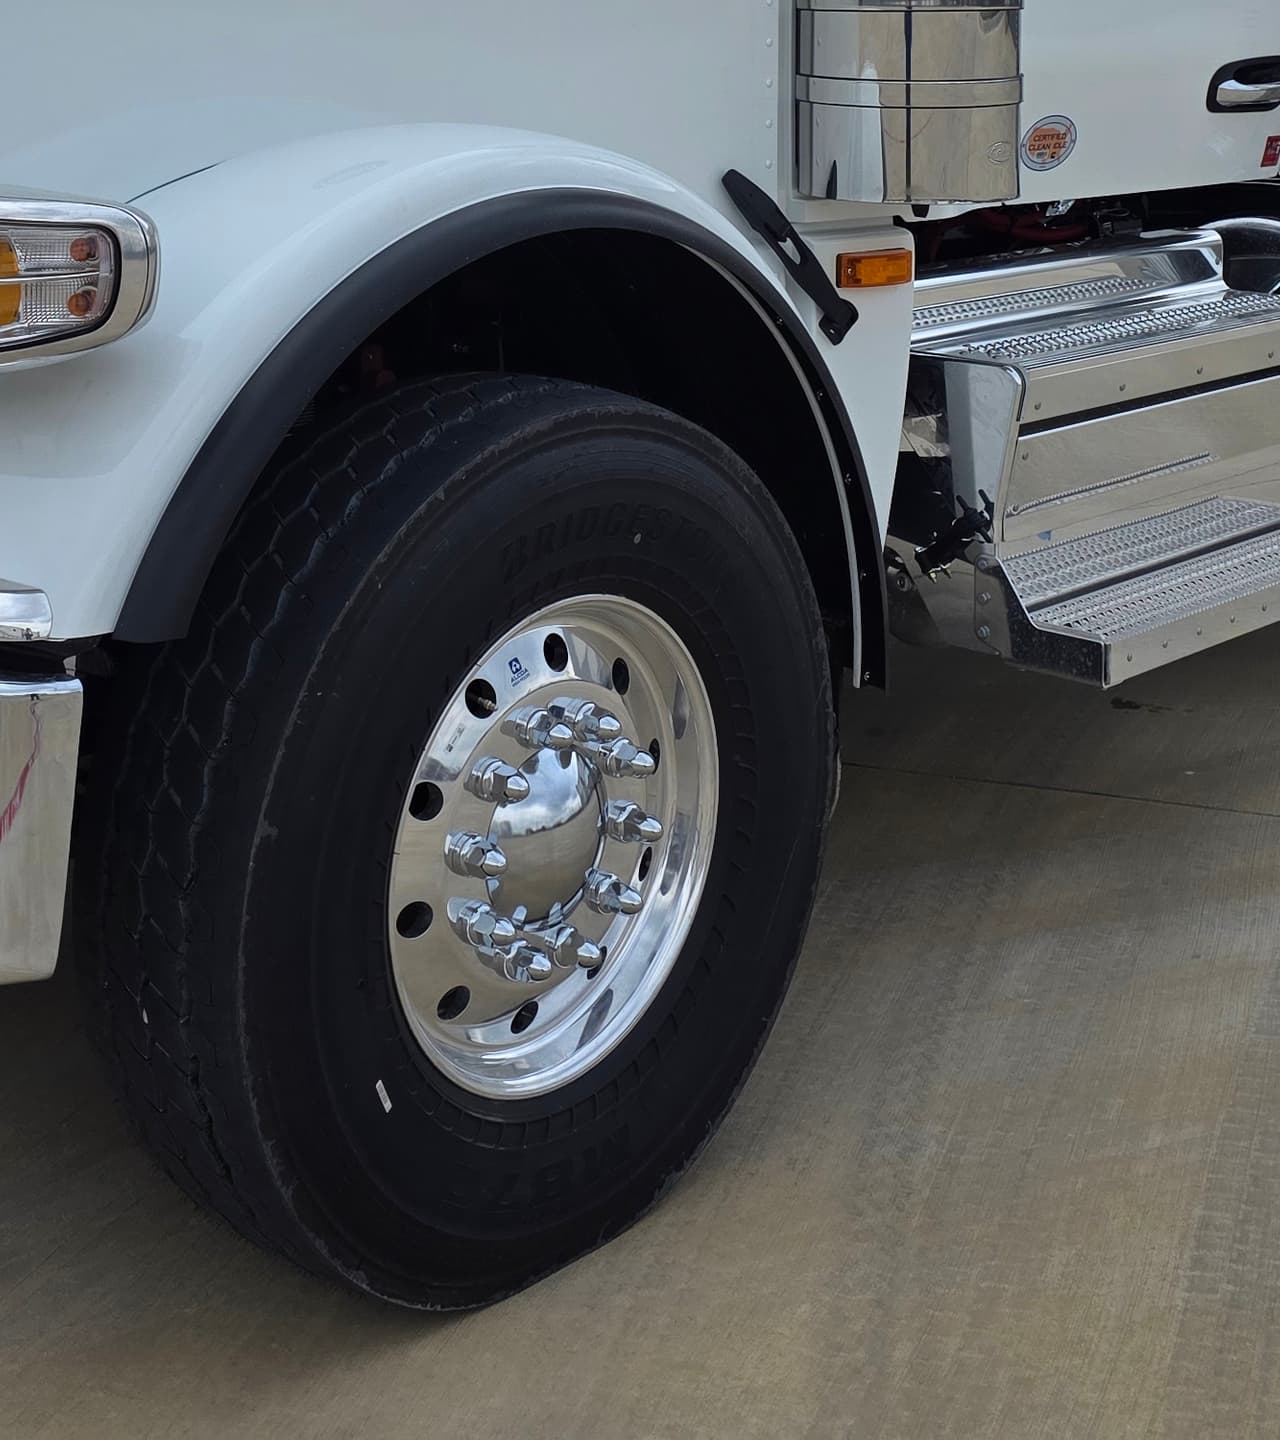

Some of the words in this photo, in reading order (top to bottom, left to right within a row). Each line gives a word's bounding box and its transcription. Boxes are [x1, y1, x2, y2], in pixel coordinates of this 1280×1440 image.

[1033, 132, 1067, 143] CERTIFIED
[1028, 142, 1050, 152] CLEAN
[1052, 140, 1068, 149] IDLE
[499, 500, 732, 590] BRIDGEST
